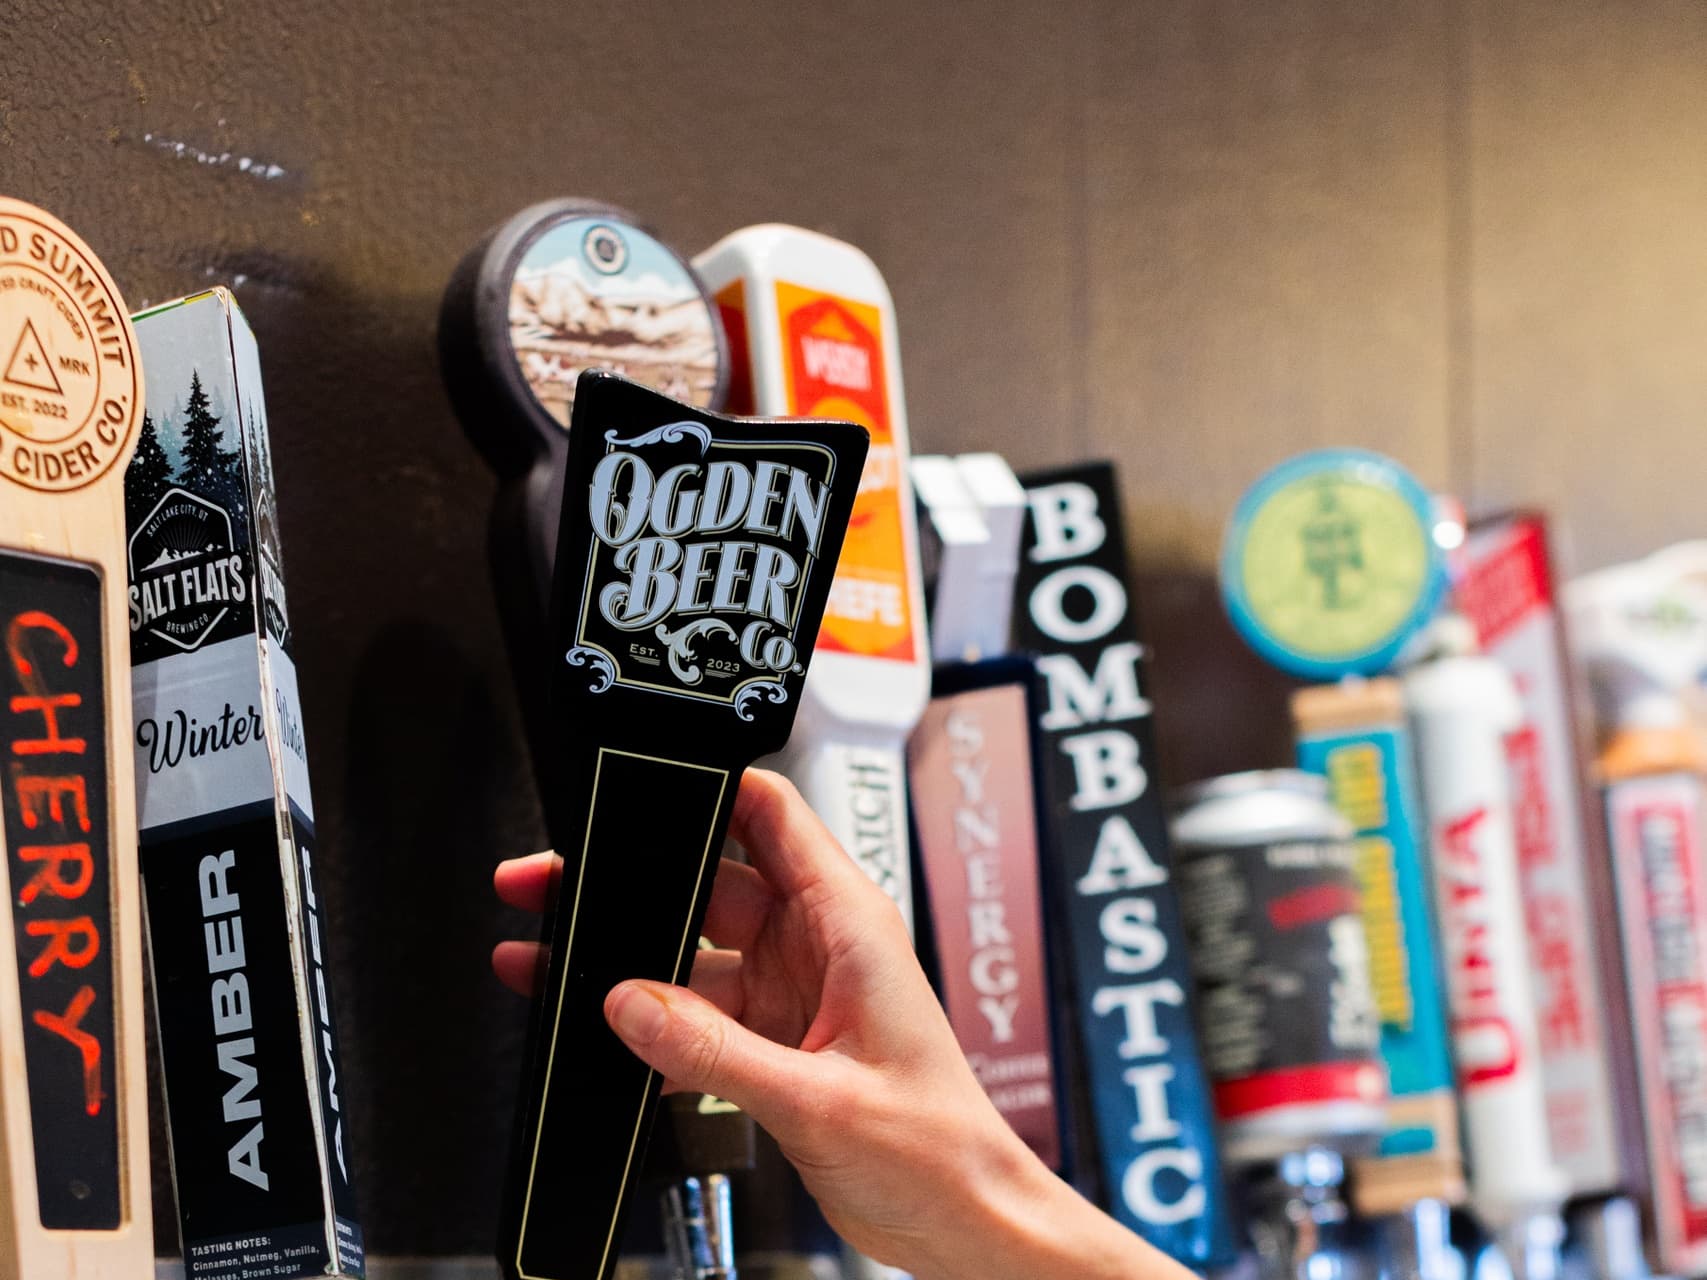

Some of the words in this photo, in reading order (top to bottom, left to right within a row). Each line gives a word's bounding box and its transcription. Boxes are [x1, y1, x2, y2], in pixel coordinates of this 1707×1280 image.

[19, 277, 57, 302] CRAFT
[29, 232, 126, 369] SUMMIT
[59, 355, 91, 376] MRK
[33, 399, 68, 420] 2022
[13, 440, 101, 482] CIDER
[95, 395, 127, 446] CO.
[146, 515, 161, 538] SALT
[162, 504, 180, 521] LAKE
[198, 511, 209, 523] UT
[589, 451, 832, 559] OGDEN
[128, 573, 176, 632] SALT
[180, 554, 247, 607] FLATS
[599, 536, 799, 631] BEER
[165, 618, 199, 634] BREWING
[629, 642, 660, 658] EST.
[740, 620, 806, 675] Co.
[706, 657, 741, 673] 2023
[136, 702, 265, 774] Winter
[6, 609, 101, 1118] CHERRY
[947, 709, 1020, 1044] SYNERGY
[1025, 480, 1205, 1226] BOMBASTIC
[198, 849, 270, 1192] AMBER
[191, 1241, 233, 1257] TASTING
[235, 1236, 272, 1250] NOTES:
[193, 1257, 242, 1272] Cinnamon,
[243, 1251, 282, 1265] Nutmeg,
[284, 1244, 320, 1258] Vanilla,
[242, 1268, 272, 1280] Brown
[273, 1263, 301, 1276] Sugar
